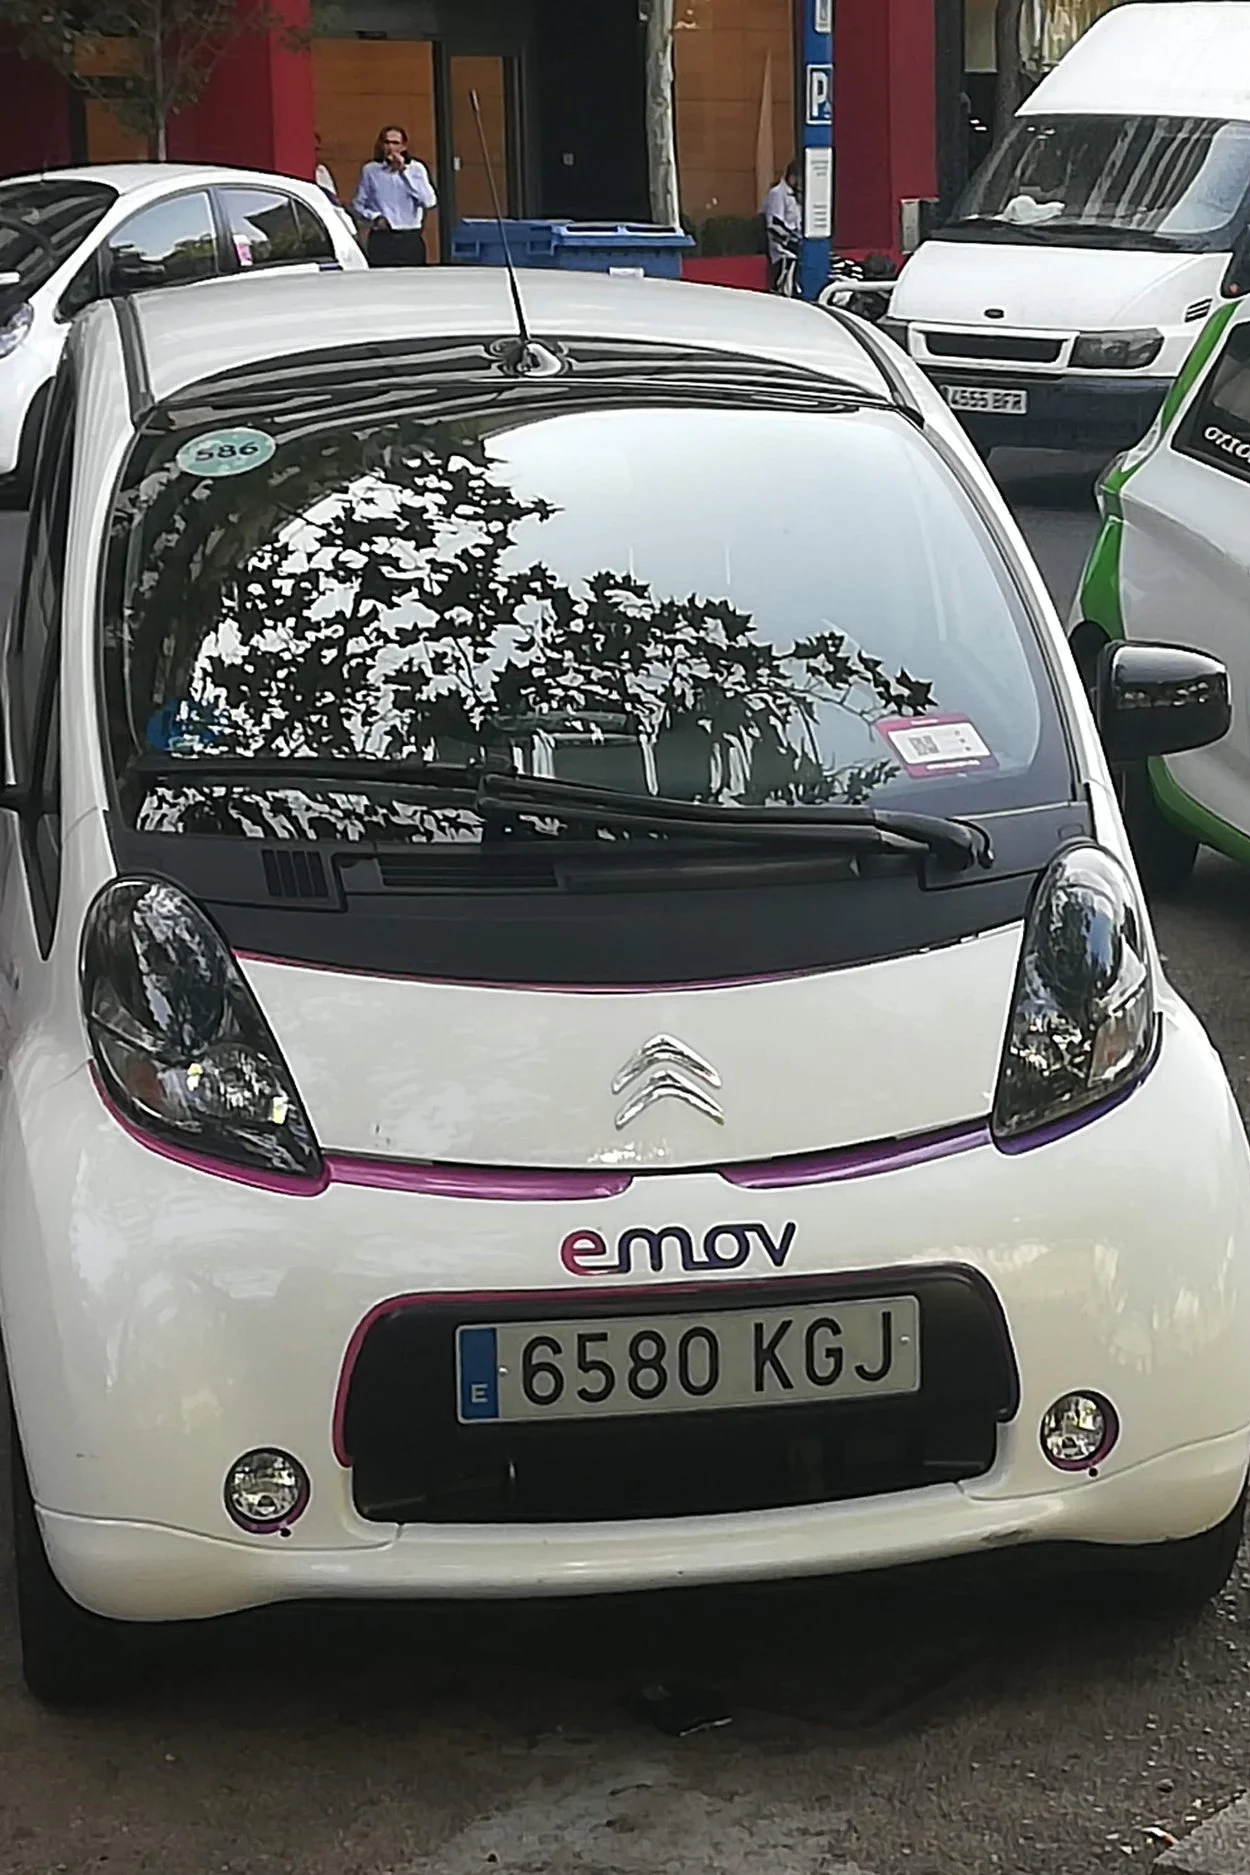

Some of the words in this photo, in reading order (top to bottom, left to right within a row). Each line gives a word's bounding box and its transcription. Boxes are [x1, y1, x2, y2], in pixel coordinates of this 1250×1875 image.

[812, 71, 828, 117] P
[195, 441, 259, 461] 586
[560, 1221, 797, 1276] emov
[468, 1384, 488, 1404] E
[522, 1326, 719, 1406] 6580
[753, 1311, 893, 1393] KGJ
